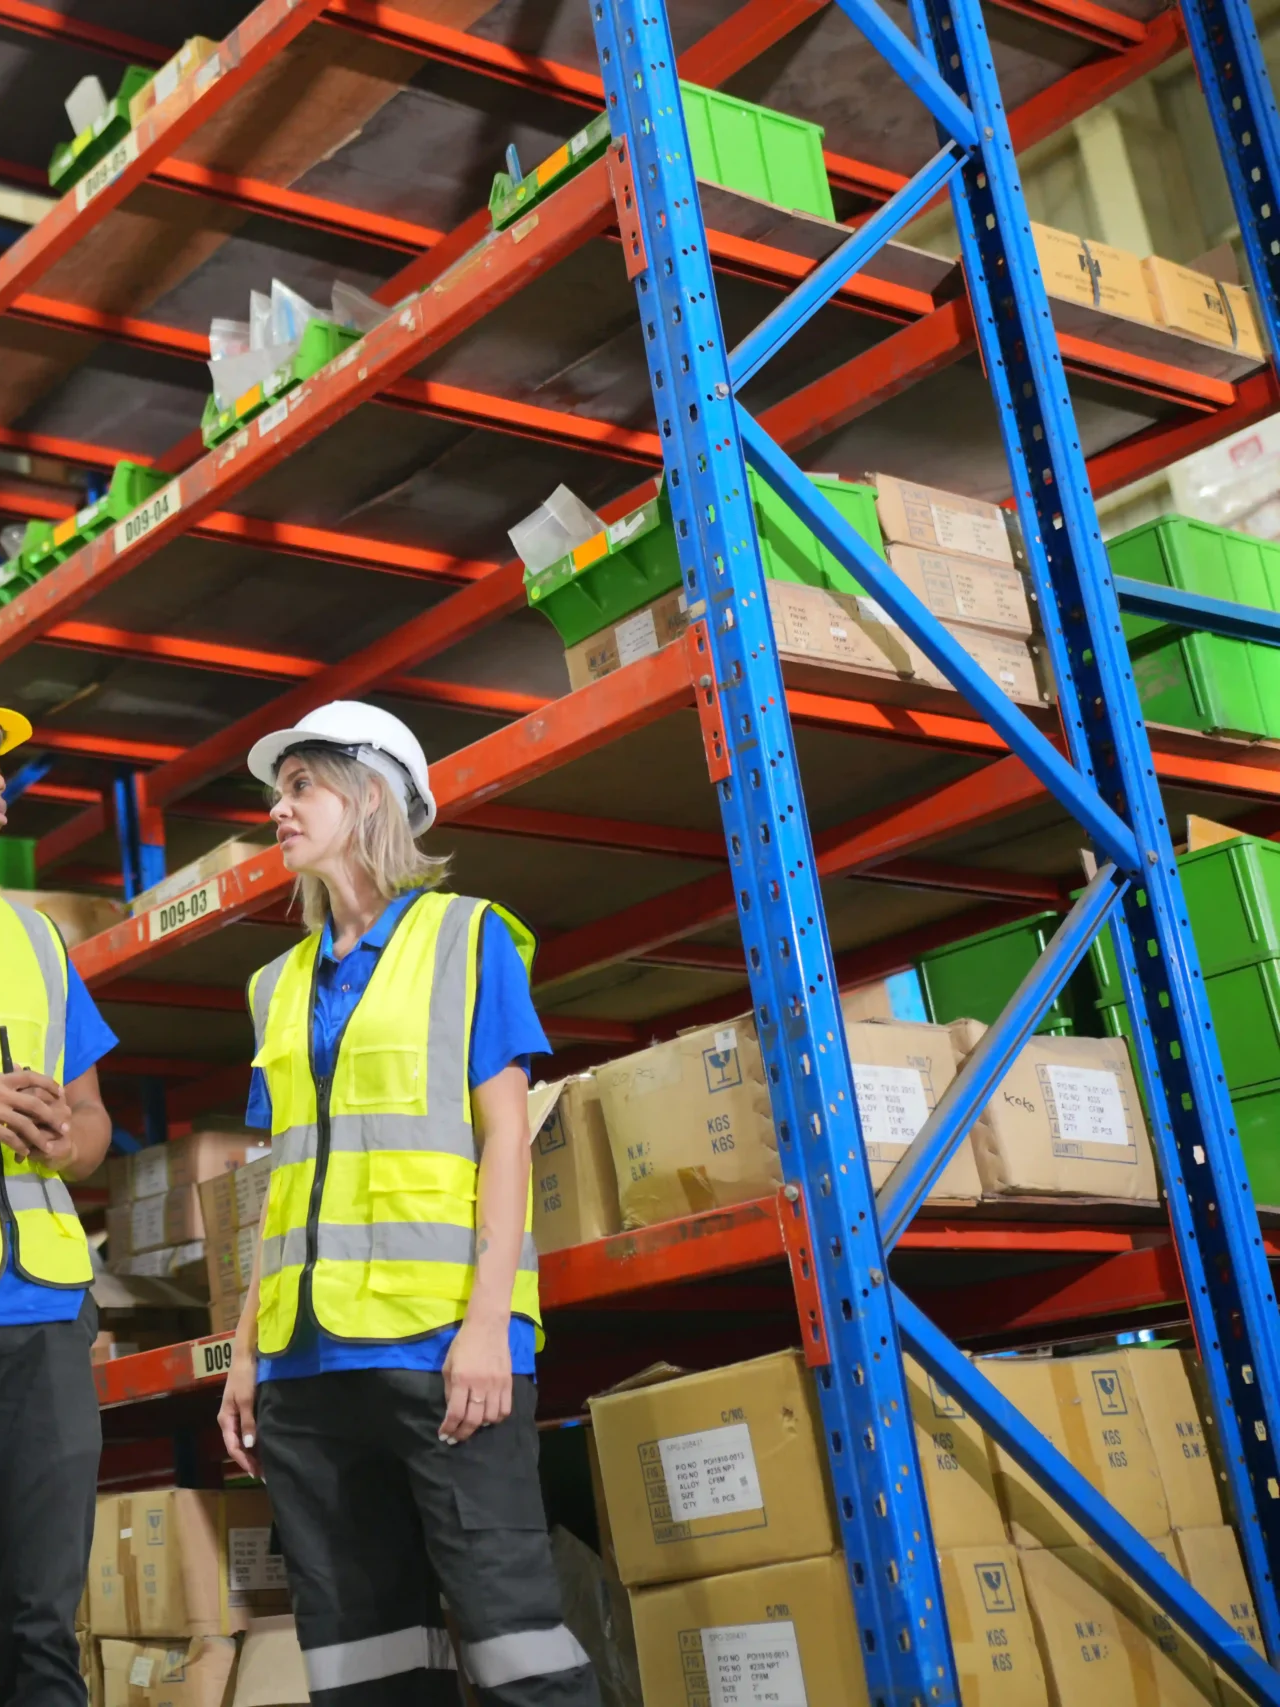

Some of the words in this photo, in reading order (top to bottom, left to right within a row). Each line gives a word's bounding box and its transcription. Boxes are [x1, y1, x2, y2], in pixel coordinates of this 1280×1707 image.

[125, 494, 169, 542] D09-04
[160, 889, 208, 932] D09-03
[707, 1114, 731, 1134] KGS
[711, 1134, 735, 1155] KGS
[540, 1174, 558, 1193] KGS
[544, 1194, 562, 1213] KGS
[721, 1408, 747, 1424] C/NO.
[932, 1432, 954, 1450] KGS
[1102, 1429, 1122, 1446] KGS
[937, 1454, 958, 1470] KGS
[1108, 1451, 1128, 1468] KGS
[680, 1481, 699, 1490] ALLOY
[708, 1476, 725, 1485] CF8M
[681, 1491, 695, 1500] SIZE
[722, 1494, 736, 1502] PCS
[986, 1629, 1008, 1646] KGS
[992, 1653, 1013, 1672] KGS
[721, 1675, 742, 1683] ALLOY
[722, 1684, 736, 1692] SIZE
[764, 1693, 779, 1701] PCS
